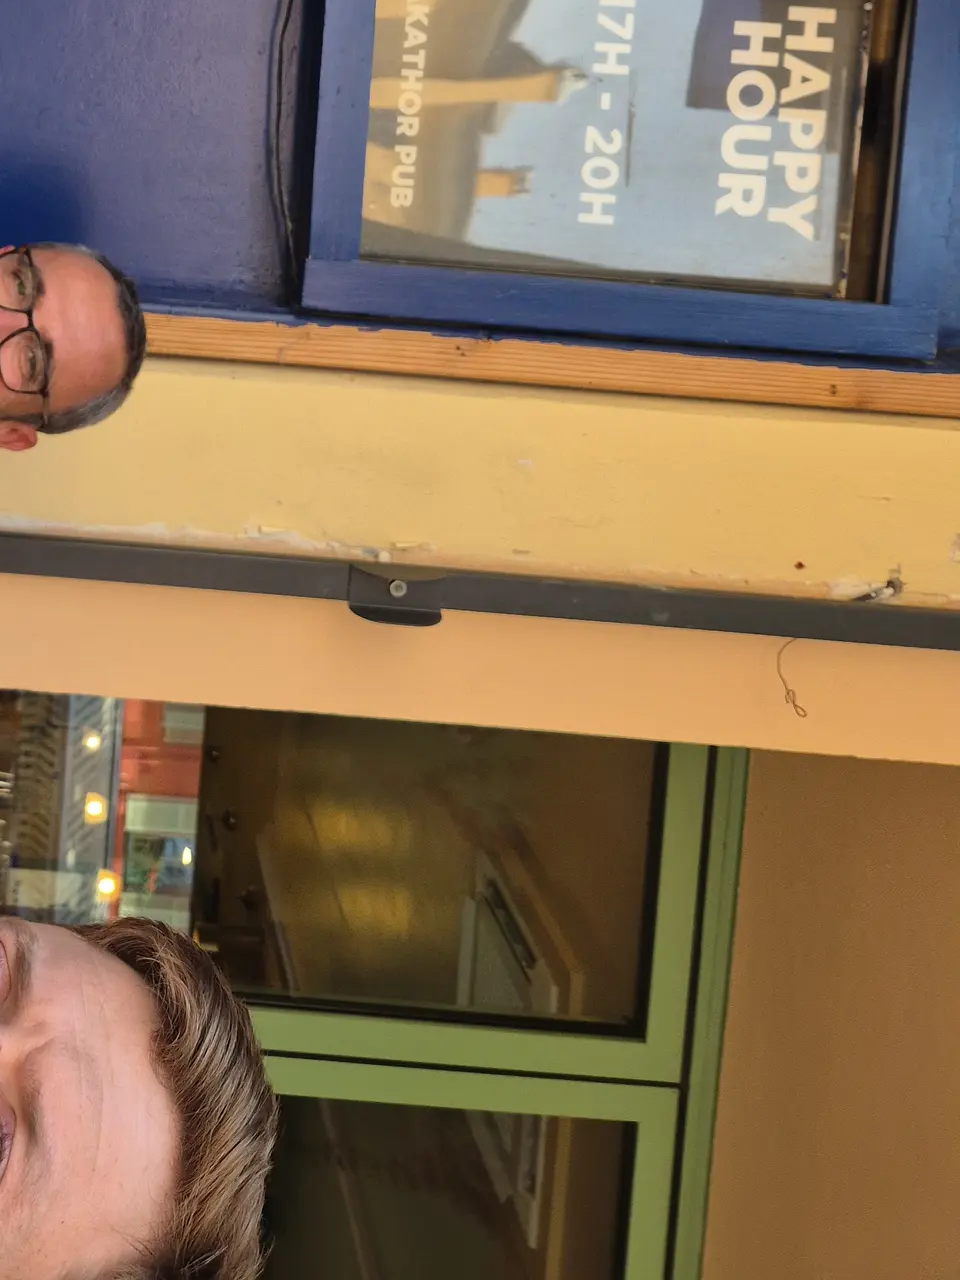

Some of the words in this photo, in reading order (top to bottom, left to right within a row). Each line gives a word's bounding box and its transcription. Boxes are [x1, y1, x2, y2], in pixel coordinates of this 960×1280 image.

[389, 145, 419, 210] PUB
[577, 124, 623, 227] 20H
[713, 20, 783, 217] HOUR
[766, 5, 838, 243] HAPPY
